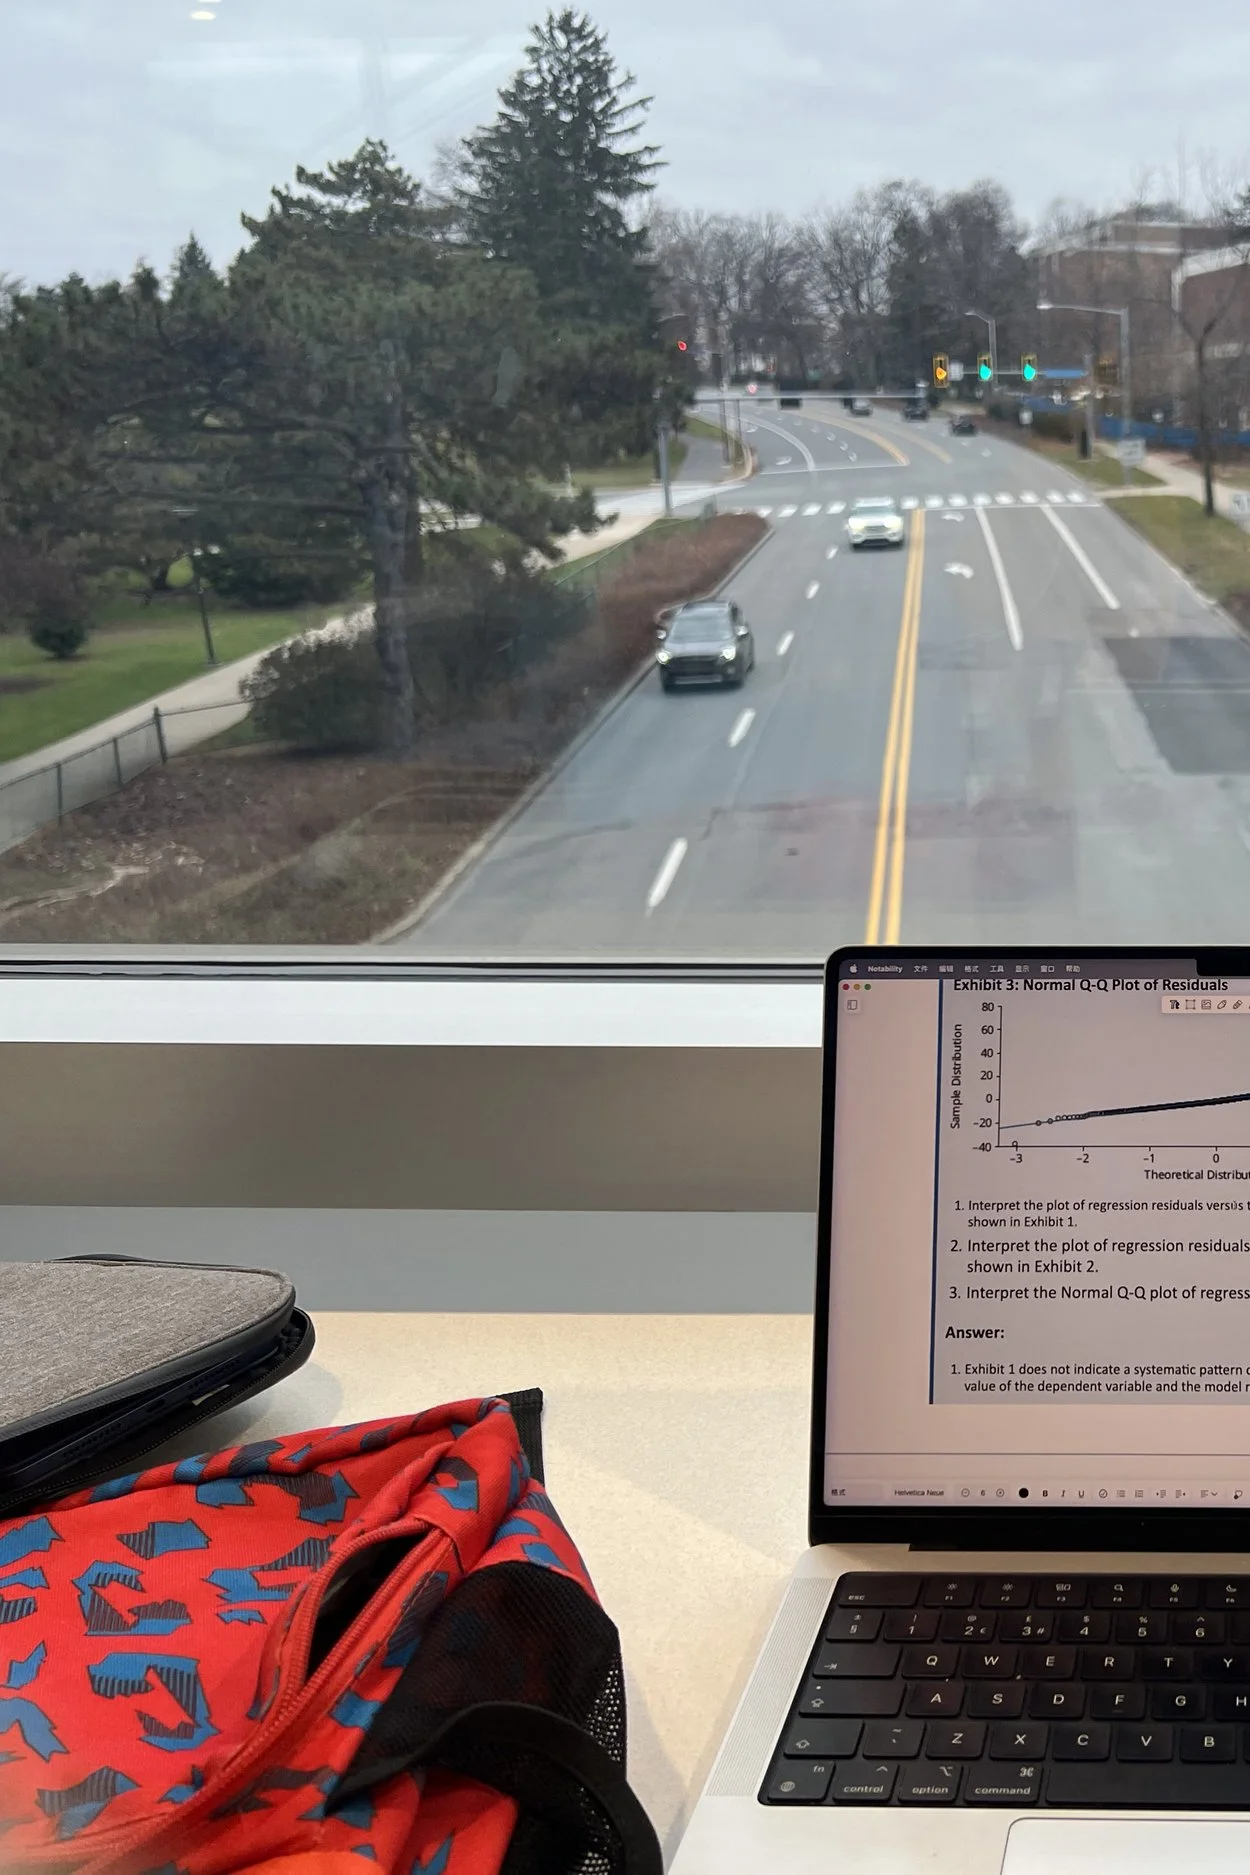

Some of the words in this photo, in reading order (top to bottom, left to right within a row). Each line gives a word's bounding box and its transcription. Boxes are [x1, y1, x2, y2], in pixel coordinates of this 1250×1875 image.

[867, 965, 903, 975] Notability
[913, 965, 929, 973] 文件
[989, 965, 1004, 973] 工具
[1040, 965, 1055, 973] 窗口
[953, 979, 1003, 991] Exhibit
[1005, 979, 1019, 991] 3:
[1023, 979, 1076, 991] Normal
[1079, 979, 1109, 993] Q-Q
[1112, 979, 1141, 991] Plot
[1143, 979, 1159, 991] of
[1162, 979, 1229, 991] Residuals
[981, 1002, 995, 1012] 80
[981, 1025, 995, 1035] 60
[951, 1024, 963, 1088] Distribution
[980, 1048, 995, 1058] 40
[980, 1070, 994, 1080] 20
[985, 1094, 993, 1103] 0
[950, 1093, 962, 1129] Sample
[1212, 1154, 1220, 1164] 0
[1143, 1169, 1204, 1180] Theoretical
[954, 1199, 965, 1211] 1.
[968, 1199, 1021, 1214] Interpret
[1023, 1199, 1044, 1211] the
[1046, 1199, 1070, 1214] plot
[1072, 1198, 1086, 1211] of
[1088, 1199, 1149, 1214] regression
[1151, 1199, 1204, 1211] residuals
[967, 1215, 1007, 1228] shown
[1009, 1215, 1021, 1228] in
[1024, 1215, 1064, 1228] Exhibit
[1067, 1215, 1078, 1228] 1.
[950, 1239, 963, 1253] 2.
[967, 1239, 1031, 1256] Interpret
[1033, 1237, 1058, 1253] the
[1061, 1237, 1090, 1256] plot
[1093, 1238, 1109, 1252] of
[1111, 1238, 1184, 1255] regression
[1188, 1238, 1250, 1253] residuals
[967, 1259, 1013, 1274] shown
[1017, 1259, 1030, 1273] in
[1034, 1258, 1083, 1273] Exhibit
[1086, 1259, 1099, 1273] 2.
[949, 1286, 961, 1300] 3.
[966, 1285, 1030, 1302] Interpret
[1032, 1285, 1057, 1299] the
[1061, 1285, 1113, 1299] Normal
[1117, 1285, 1147, 1301] Q-Q
[1149, 1285, 1178, 1302] plot
[1181, 1285, 1197, 1300] of
[944, 1325, 1005, 1339] Answer:
[951, 1363, 961, 1375] 1.
[964, 1363, 1005, 1375] Exhibit
[1008, 1363, 1016, 1375] 1
[1018, 1363, 1047, 1375] does
[1050, 1364, 1071, 1375] not
[1073, 1363, 1121, 1376] indicate
[1123, 1366, 1131, 1375] a
[1133, 1363, 1197, 1378] systematic
[1199, 1364, 1243, 1378] pattern
[964, 1379, 996, 1392] value
[998, 1379, 1013, 1392] of
[1014, 1379, 1035, 1392] the
[1037, 1379, 1103, 1394] dependent
[1104, 1380, 1153, 1393] variable
[1155, 1380, 1178, 1393] and
[1181, 1380, 1202, 1393] the
[1204, 1380, 1242, 1393] model
[894, 1489, 925, 1497] Helvetica
[926, 1655, 938, 1667] Q
[984, 1656, 999, 1666] W
[1045, 1656, 1056, 1667] E
[1104, 1656, 1115, 1667] R
[1164, 1657, 1174, 1668] T
[1223, 1657, 1234, 1668] Y
[813, 1764, 825, 1773] fn
[843, 1784, 884, 1794] control
[912, 1785, 949, 1796] option
[975, 1786, 1031, 1796] command
